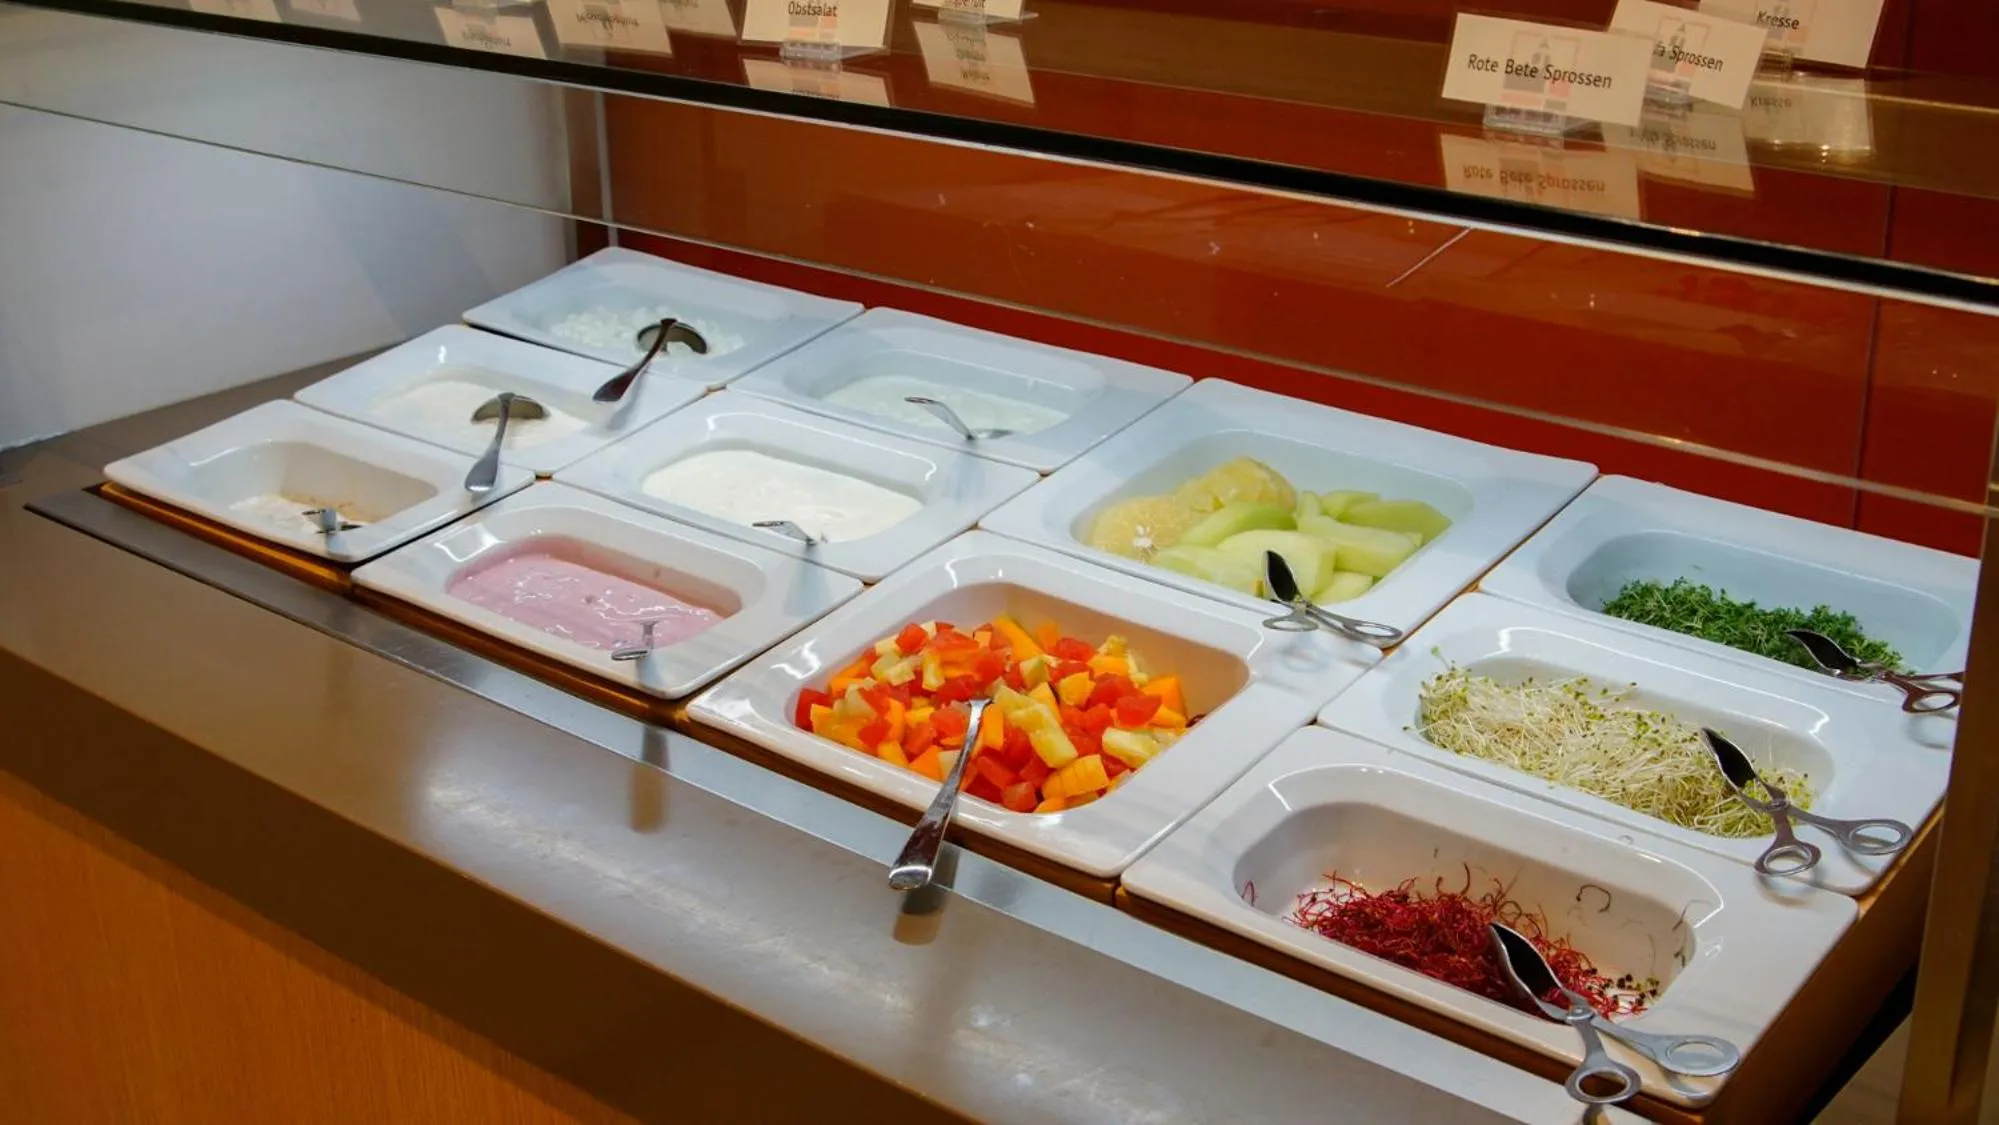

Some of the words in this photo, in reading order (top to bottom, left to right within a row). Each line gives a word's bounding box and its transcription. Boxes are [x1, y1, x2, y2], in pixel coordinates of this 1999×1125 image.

[788, 2, 838, 18] Obstsalat
[1756, 10, 1800, 30] Kresse
[1669, 45, 1724, 72] Sprossen
[1467, 53, 1499, 73] Rote
[1504, 58, 1539, 78] Bete
[1543, 64, 1612, 89] Sprossen
